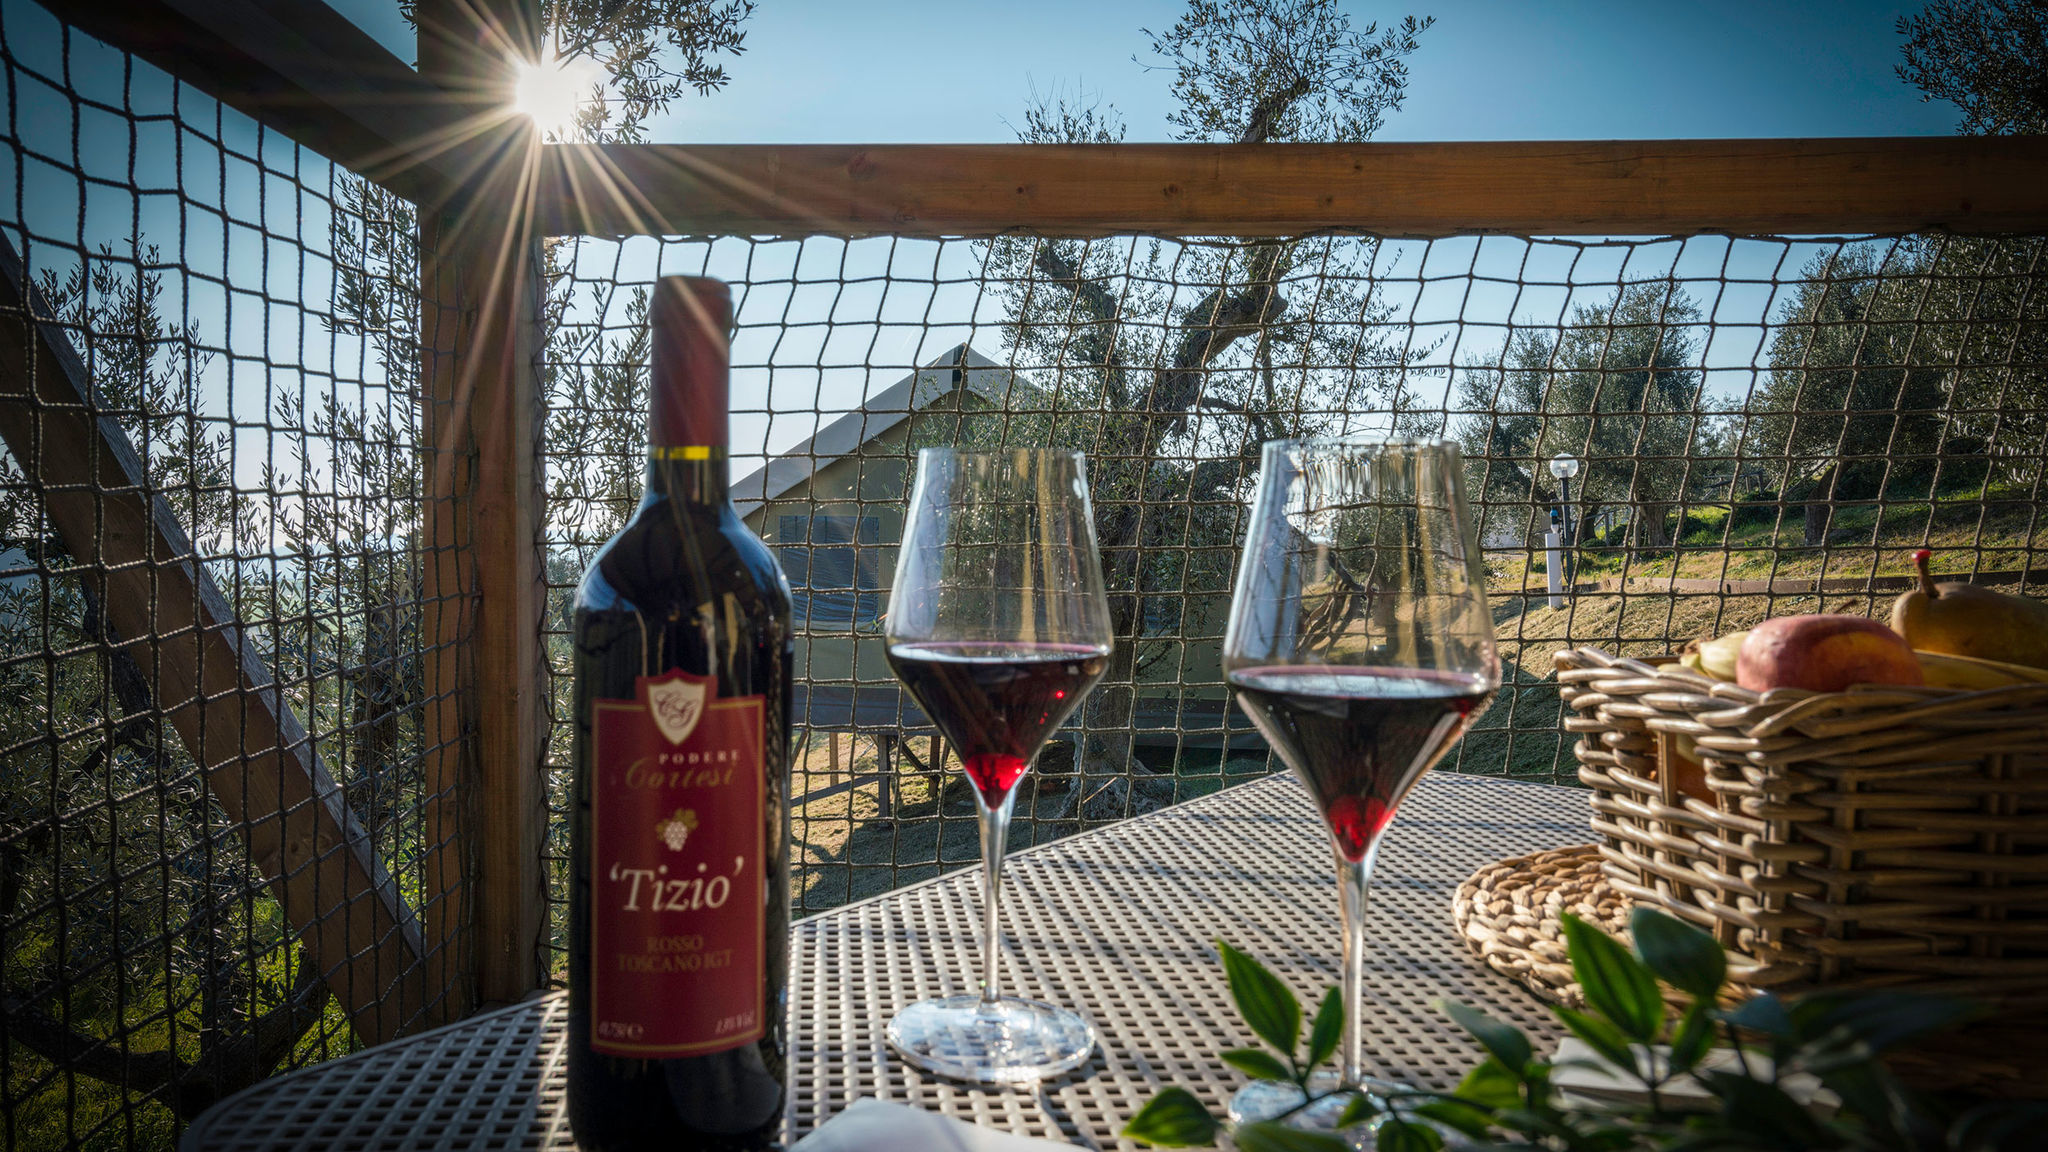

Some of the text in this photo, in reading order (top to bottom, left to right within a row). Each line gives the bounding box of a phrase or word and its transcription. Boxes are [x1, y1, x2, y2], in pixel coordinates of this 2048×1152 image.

[647, 934, 704, 953] ROSSO
[616, 948, 734, 973] TOSCANO IGT
